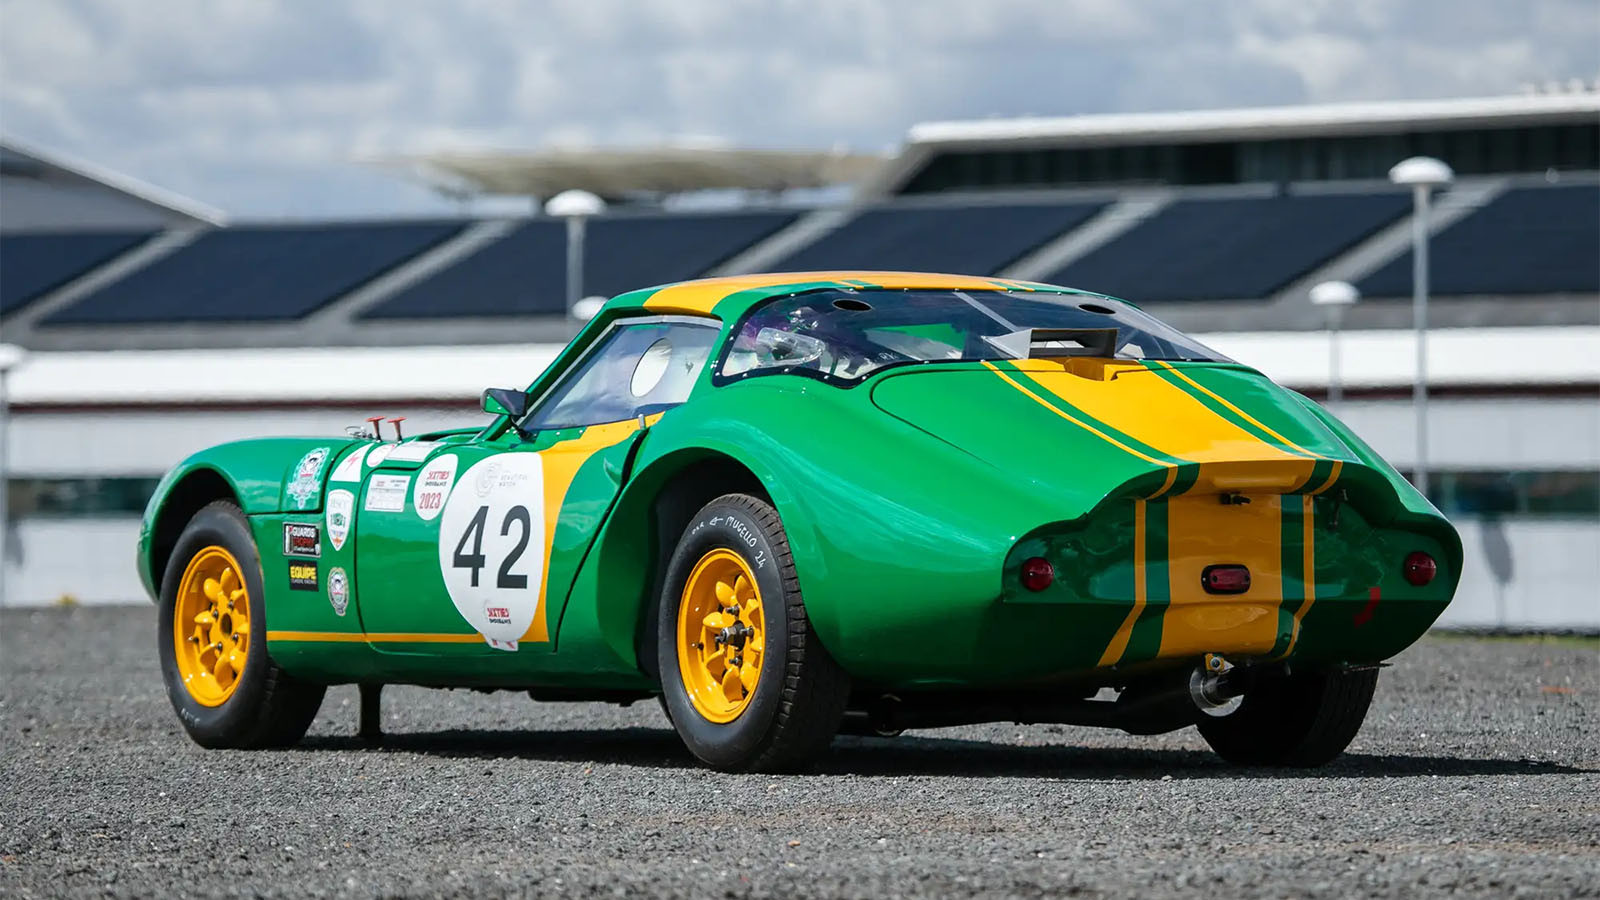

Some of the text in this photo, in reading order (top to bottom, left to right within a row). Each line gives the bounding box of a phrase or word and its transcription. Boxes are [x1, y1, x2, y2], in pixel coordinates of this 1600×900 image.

[427, 471, 449, 480] SIXTIES
[419, 492, 442, 509] 2023
[293, 527, 316, 538] GUARDS
[453, 505, 531, 589] 42
[725, 516, 766, 569] MUGELLO 24
[290, 566, 316, 579] EQUIPE
[487, 608, 510, 617] SIXTIES
